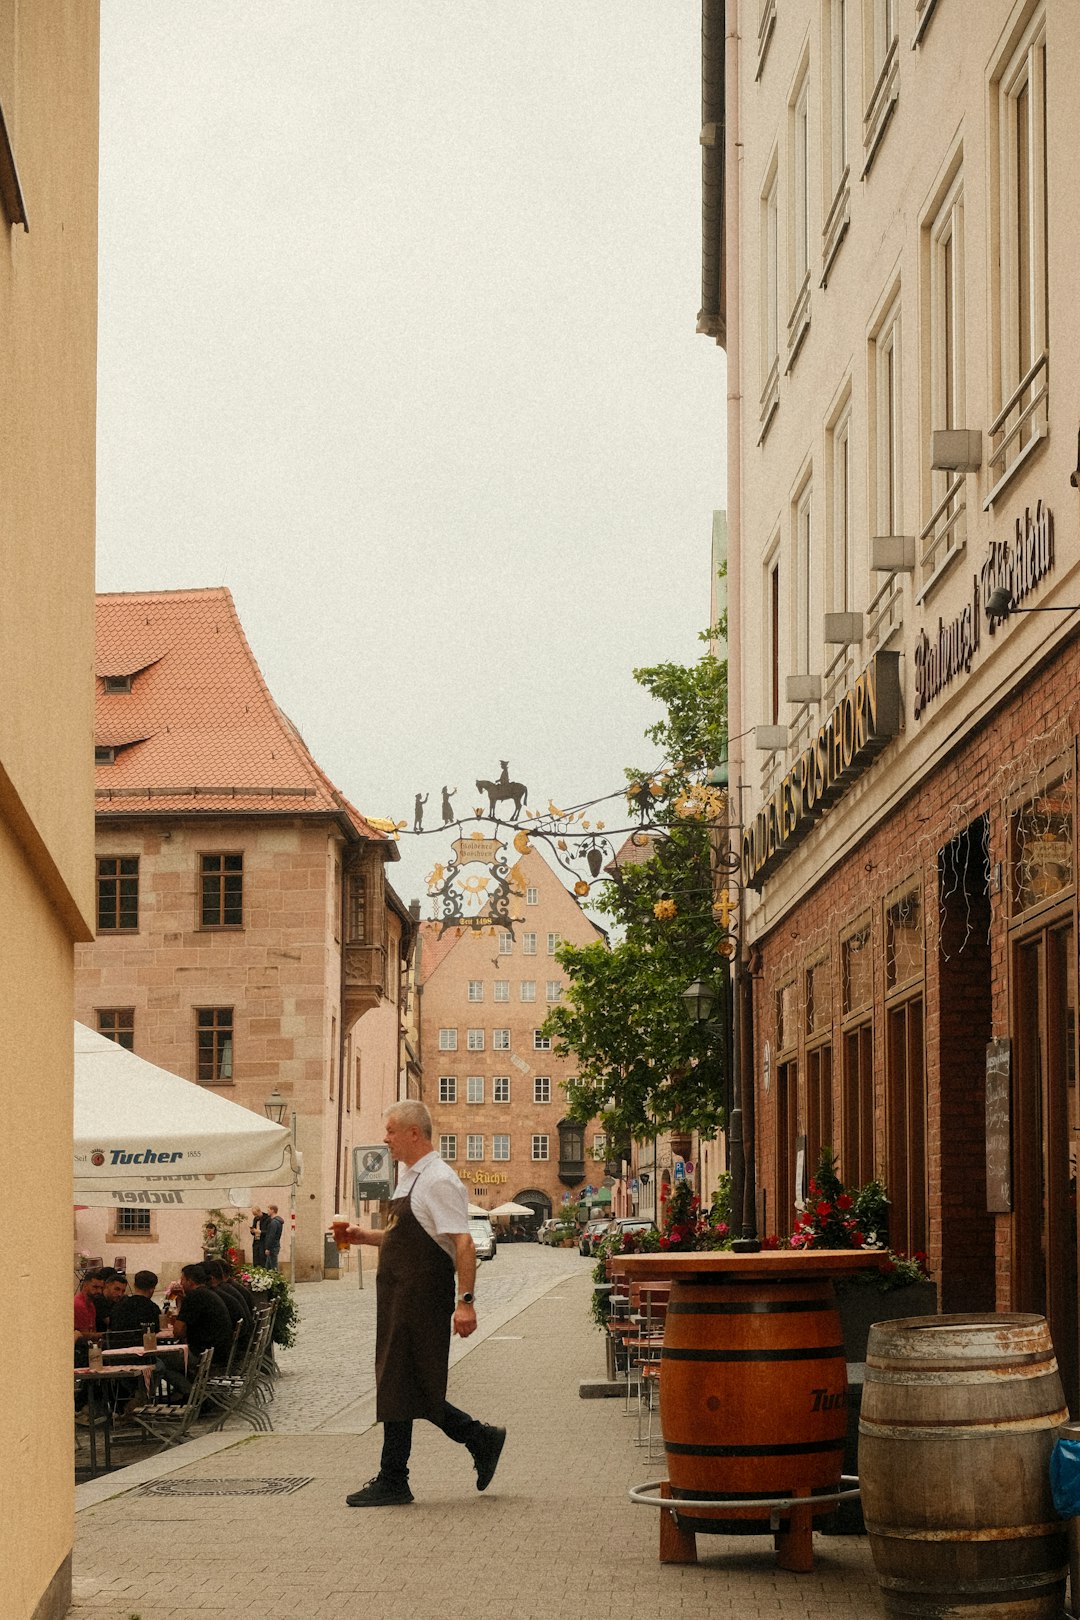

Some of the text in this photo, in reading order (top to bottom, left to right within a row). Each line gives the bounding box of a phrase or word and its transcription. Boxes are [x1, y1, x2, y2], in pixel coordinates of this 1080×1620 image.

[742, 654, 877, 888] GOLDENES POSTHORN
[74, 1154, 87, 1162] Seit
[110, 1149, 183, 1165] Tucher
